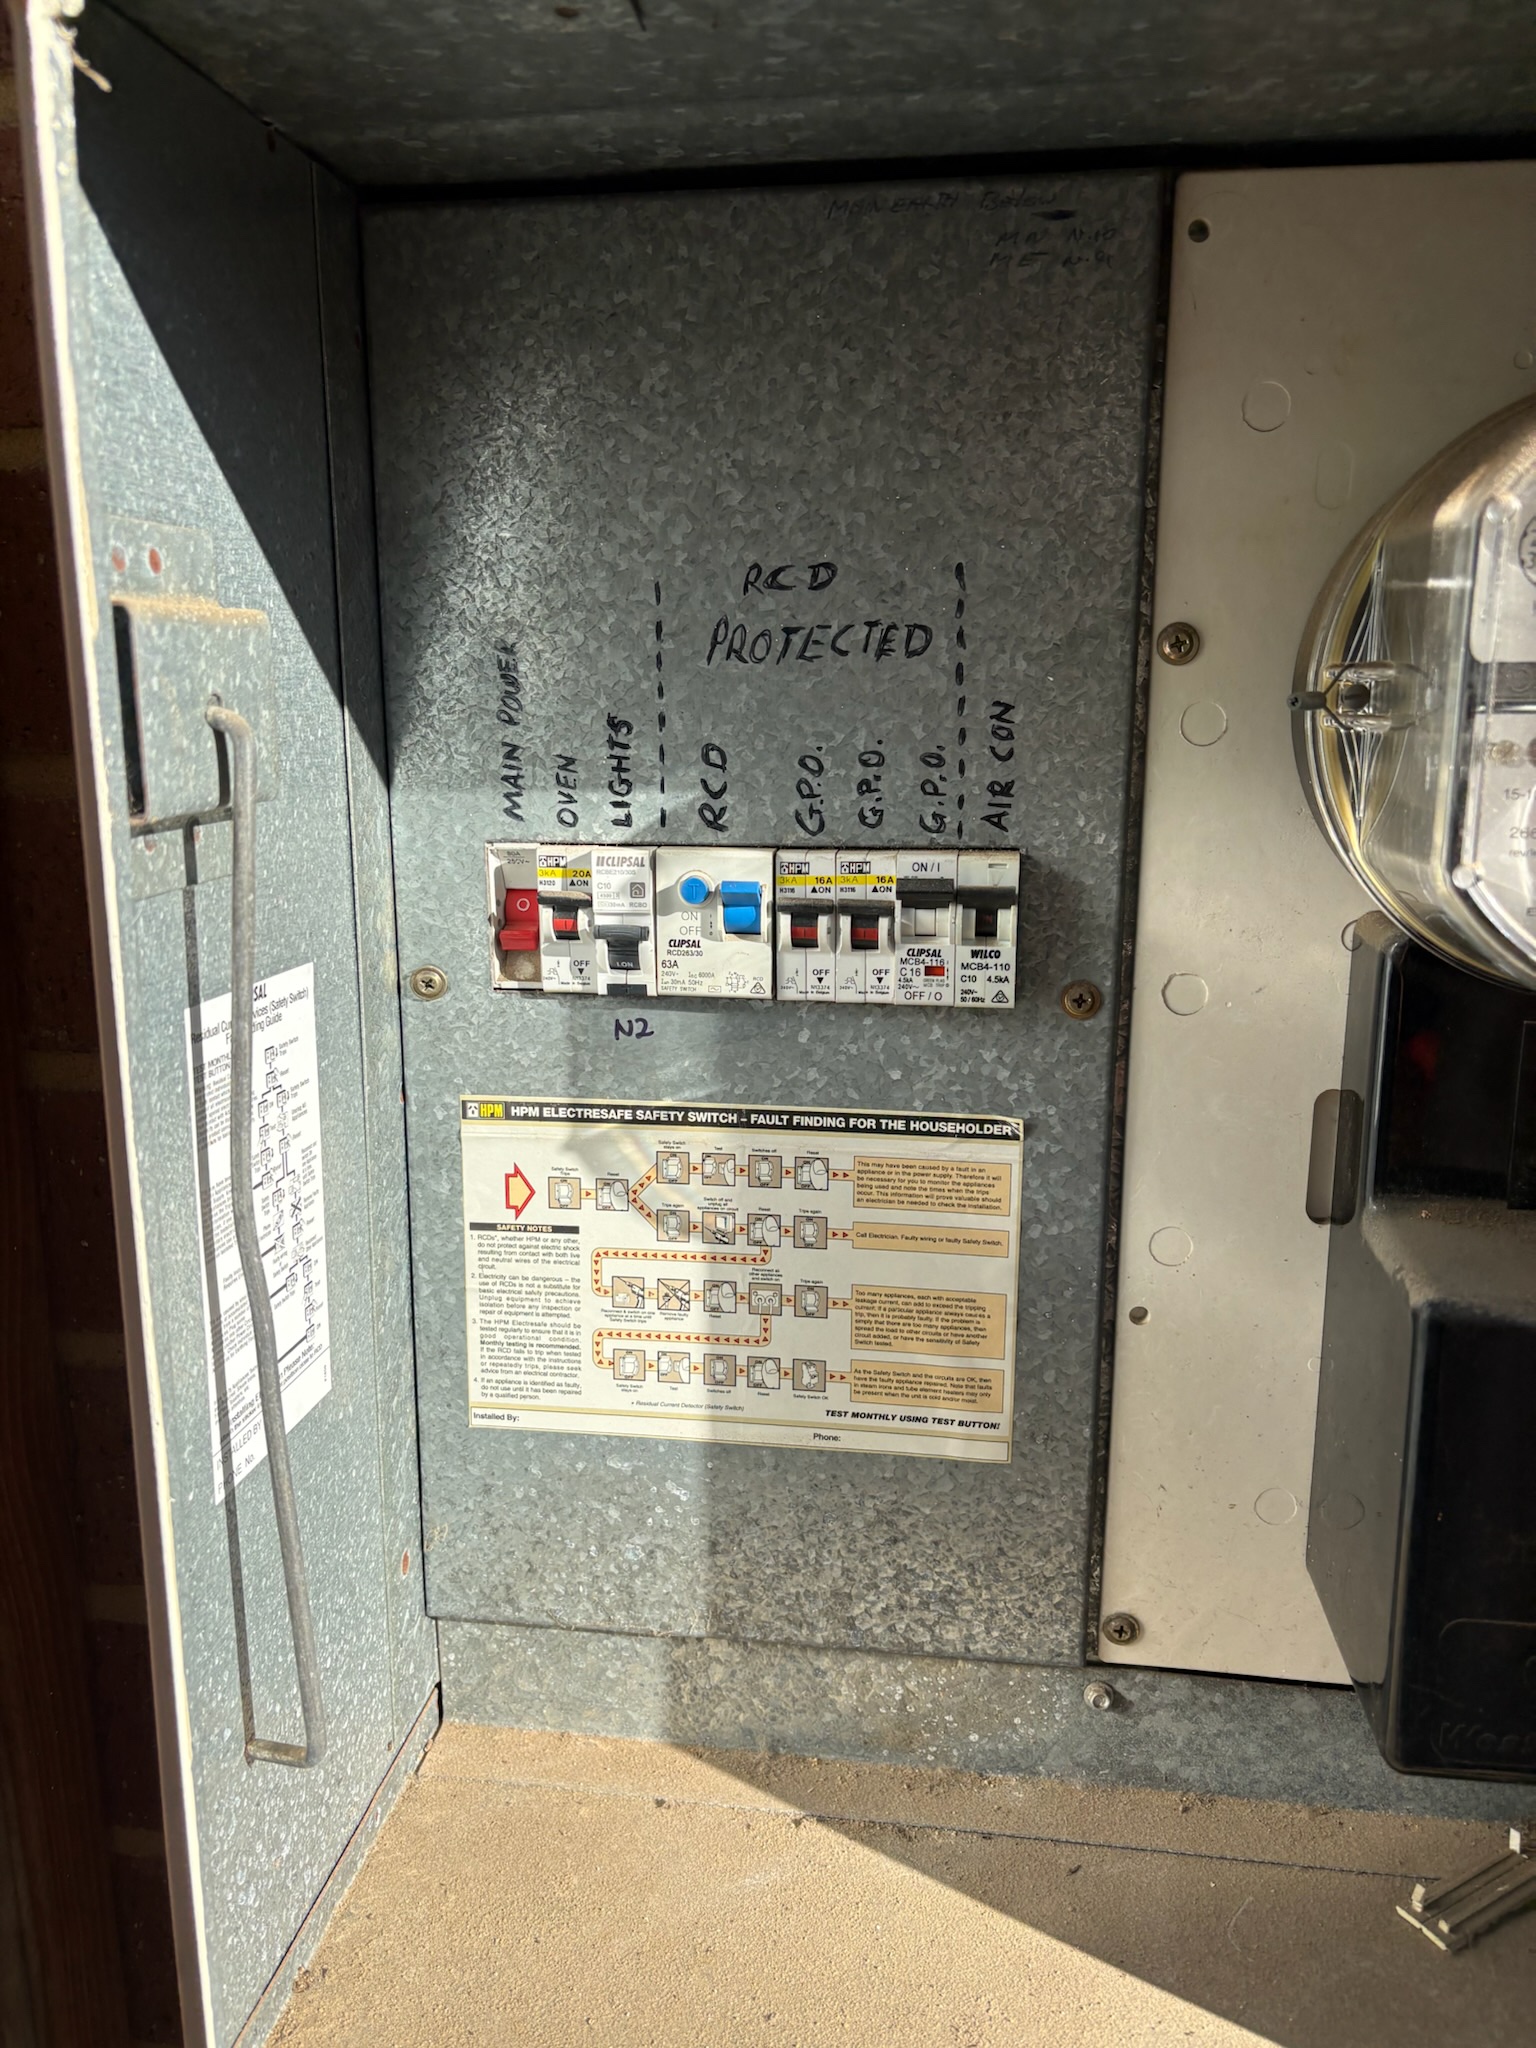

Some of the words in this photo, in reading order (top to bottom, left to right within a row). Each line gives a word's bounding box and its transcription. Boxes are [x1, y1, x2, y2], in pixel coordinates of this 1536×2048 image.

[743, 562, 838, 595] RCD
[706, 614, 933, 665] PROTECTED
[990, 701, 1015, 762] CON
[607, 712, 633, 827] LIGHTS
[500, 742, 525, 822] MAIN
[698, 743, 729, 831] RCD
[553, 754, 578, 828] OVEN
[980, 780, 1015, 832] AIR
[547, 856, 567, 868] HPM
[606, 856, 645, 867] CLIPSAL
[788, 862, 809, 874] HPM
[849, 862, 870, 873] HPM
[912, 862, 928, 872] ON
[840, 876, 859, 884] 3kA
[876, 876, 894, 884] 16A
[681, 911, 698, 920] ON
[680, 926, 701, 935] OFF
[669, 939, 701, 948] CLIPSAL
[907, 948, 941, 957] CLIPSAL
[971, 949, 1001, 959] WILCO
[661, 960, 679, 968] 63A
[900, 958, 944, 966] MCB4-116
[961, 963, 1010, 971] MCB4-110
[900, 968, 907, 976] C
[910, 968, 921, 976] 16
[961, 975, 977, 983] C10
[904, 991, 925, 1000] OFF
[615, 1018, 654, 1040] N2
[479, 1104, 503, 1117] HPM
[511, 1109, 540, 1118] HPM
[543, 1108, 633, 1120] ELECTRESAFE
[636, 1110, 683, 1121] SAFETY
[688, 1112, 737, 1124] SWITCH
[750, 1113, 789, 1126] FAULT
[792, 1115, 845, 1128] FINDING
[849, 1117, 876, 1129] FOR
[880, 1120, 905, 1131] THE
[910, 1121, 1012, 1136] HOUSEHOLDER
[473, 1412, 505, 1421] Installed
[507, 1414, 520, 1422] By:
[826, 1409, 848, 1417] TEST
[851, 1412, 897, 1421] MONTHLY
[900, 1415, 929, 1424] USING
[931, 1417, 956, 1426] TEST
[958, 1420, 1000, 1430] BUTTON!
[813, 1433, 841, 1442] Phone:
